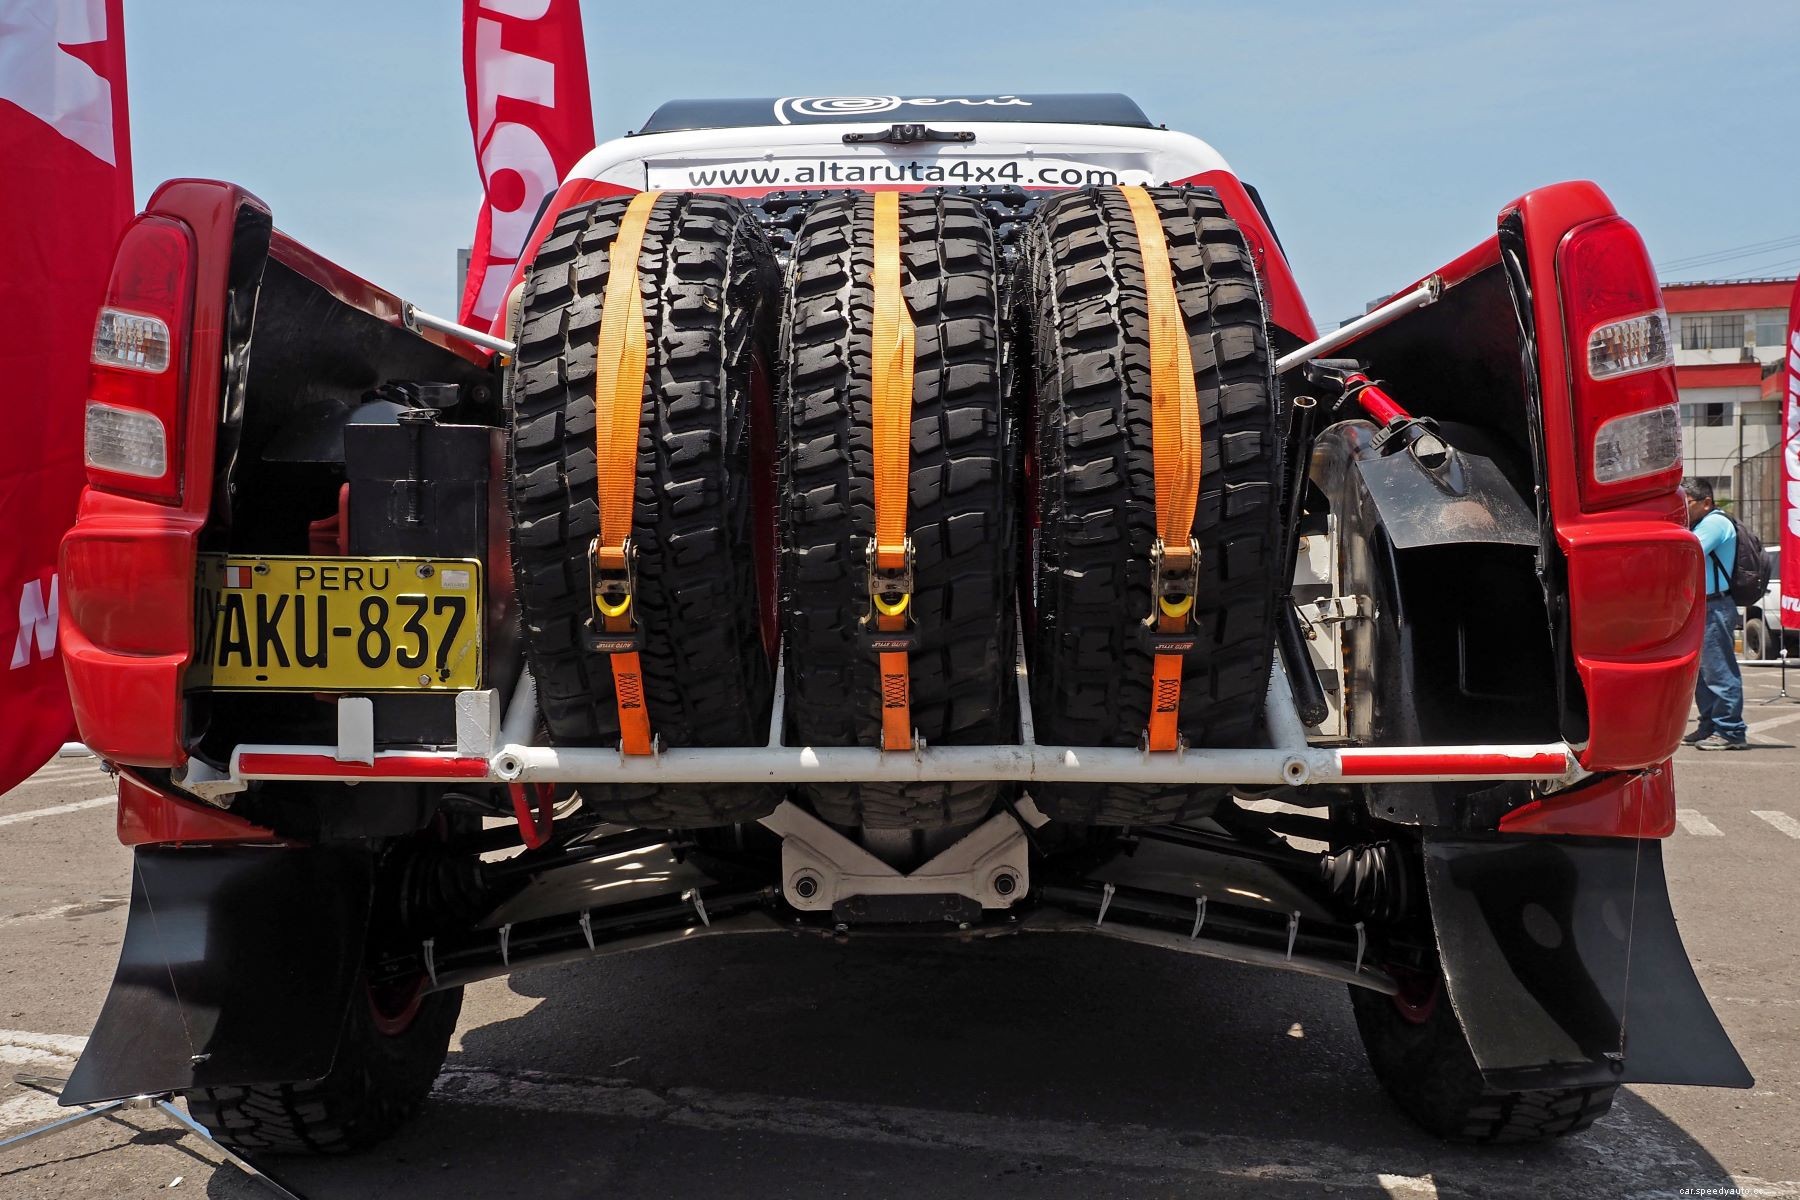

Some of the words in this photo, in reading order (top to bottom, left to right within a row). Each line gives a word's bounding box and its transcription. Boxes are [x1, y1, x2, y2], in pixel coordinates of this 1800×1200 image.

[473, 0, 559, 321] OT
[689, 161, 1117, 186] www.altaruta4x4.com
[296, 566, 389, 590] PERU
[218, 593, 467, 669] AKU-837
